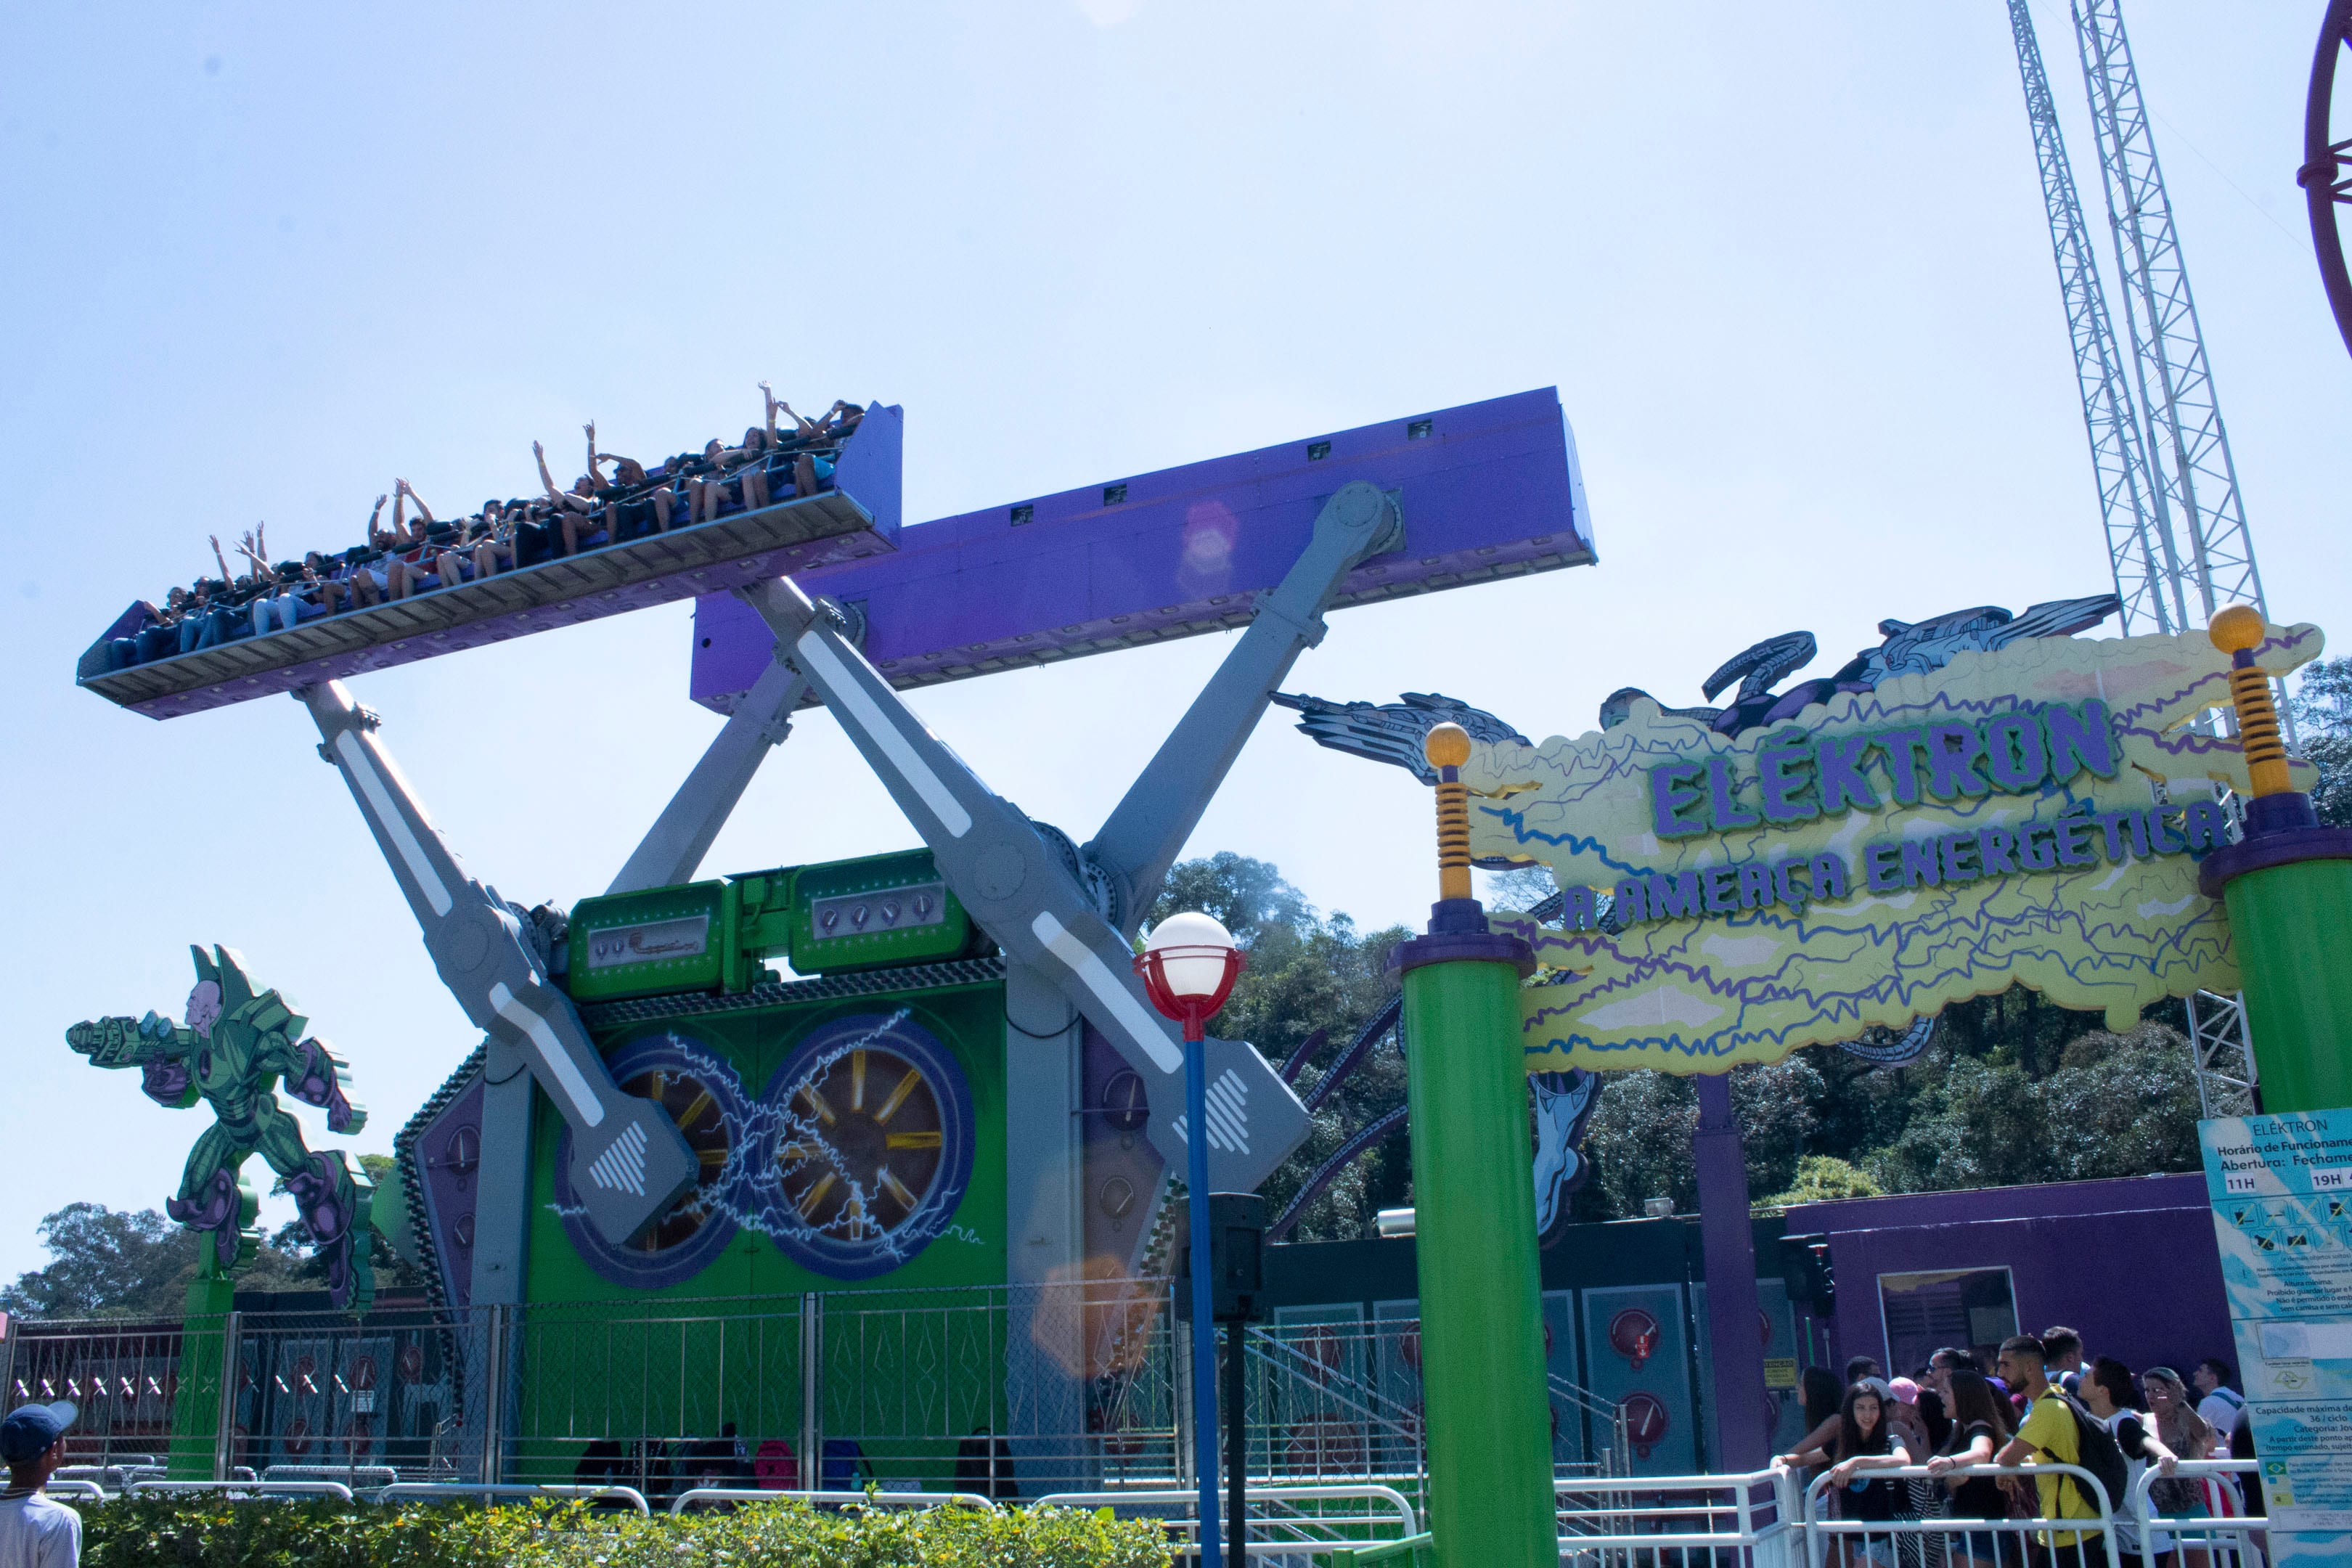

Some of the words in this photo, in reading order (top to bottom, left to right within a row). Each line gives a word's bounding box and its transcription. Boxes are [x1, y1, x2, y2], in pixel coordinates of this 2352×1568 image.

[1649, 698, 2115, 841] ELÉKTRON
[1563, 885, 1596, 932] A
[1613, 852, 1847, 927] AMEAÇA
[1864, 801, 2225, 894] ENERGÉTICA
[2253, 1119, 2328, 1136] ELÉKTRON
[2217, 1144, 2262, 1156] Horário
[2264, 1142, 2279, 1153] de
[2221, 1159, 2285, 1171] Abertura:
[2228, 1178, 2255, 1189] 11H
[2314, 1174, 2342, 1186] 19H
[2297, 1294, 2329, 1304] permitido
[2255, 1406, 2305, 1416] Capacidade
[2294, 1425, 2337, 1434] Categoria:
